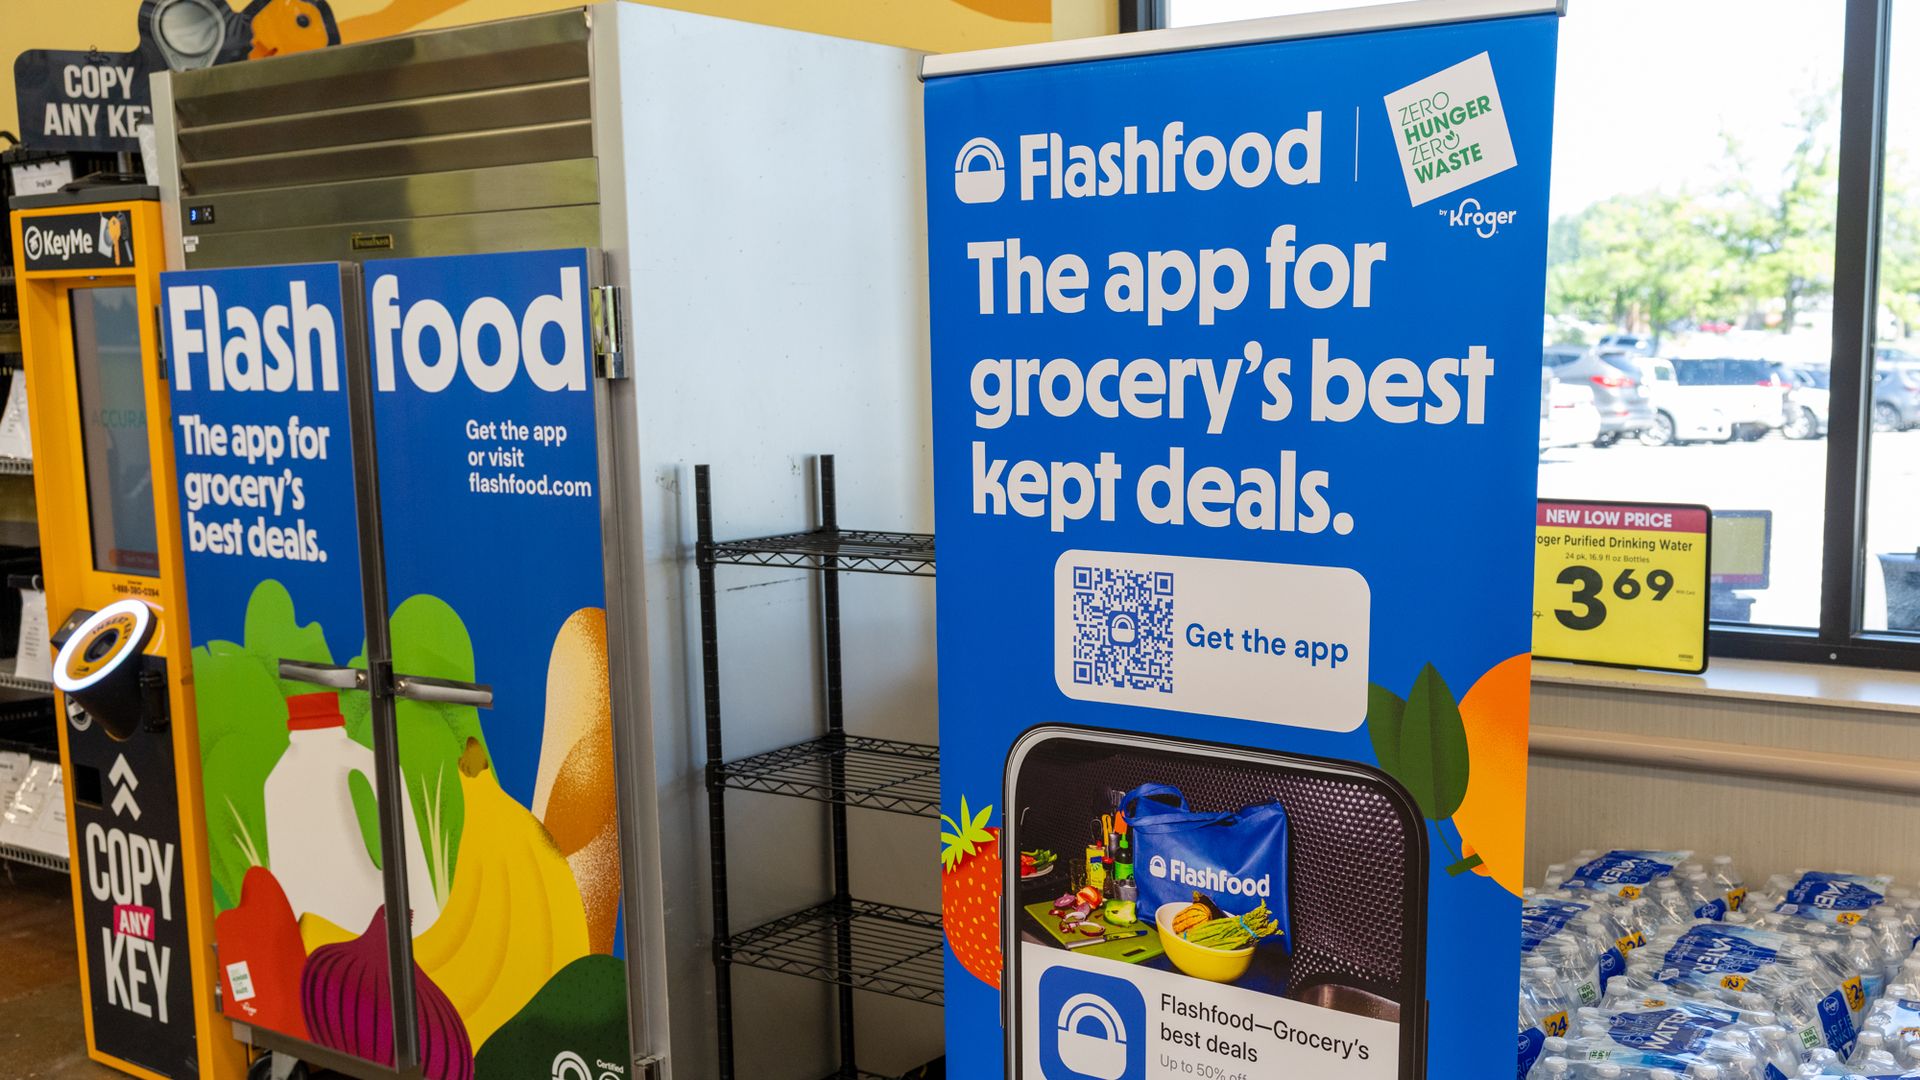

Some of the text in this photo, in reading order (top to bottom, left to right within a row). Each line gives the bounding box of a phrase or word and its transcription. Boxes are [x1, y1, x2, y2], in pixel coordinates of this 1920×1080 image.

[64, 65, 134, 99] COPY
[44, 103, 151, 138] ANY KE
[1398, 91, 1450, 126] ZERO
[1404, 95, 1492, 145] HUNGER
[1020, 111, 1322, 201] Flashfood
[1408, 130, 1460, 165] ZERO
[1414, 142, 1483, 184] WASTE
[1449, 198, 1517, 239] Kroger
[43, 227, 93, 260] KeyMe
[967, 224, 1386, 326] The app for
[168, 280, 340, 392] Flash
[371, 266, 587, 393] food
[970, 338, 1494, 434] grocery’s best
[179, 415, 330, 465] The app for
[465, 419, 567, 446] Get the app
[468, 446, 525, 468] or visit
[184, 468, 305, 516] grocery’s
[468, 472, 592, 497] flashfood.com
[972, 441, 1354, 535] kept deals.
[187, 512, 328, 563] best deals.
[1546, 509, 1672, 528] NEW LOW PRICE
[1564, 534, 1605, 548] Purified
[1609, 537, 1656, 552] Drinking
[1660, 539, 1693, 551] Water
[1565, 552, 1575, 560] 24
[1623, 555, 1650, 563] Bottles
[1185, 623, 1349, 669] Get the app
[85, 822, 174, 921] COPY
[1170, 858, 1270, 897] Flashfood
[119, 909, 151, 937] ANY
[102, 927, 171, 1023] KEY
[1160, 1022, 1258, 1063] best deals
[1550, 1015, 1568, 1036] 24
[596, 1059, 624, 1074] Certified
[1160, 1054, 1178, 1071] Up
[1181, 1060, 1193, 1073] to
[1196, 1063, 1225, 1080] 50%
